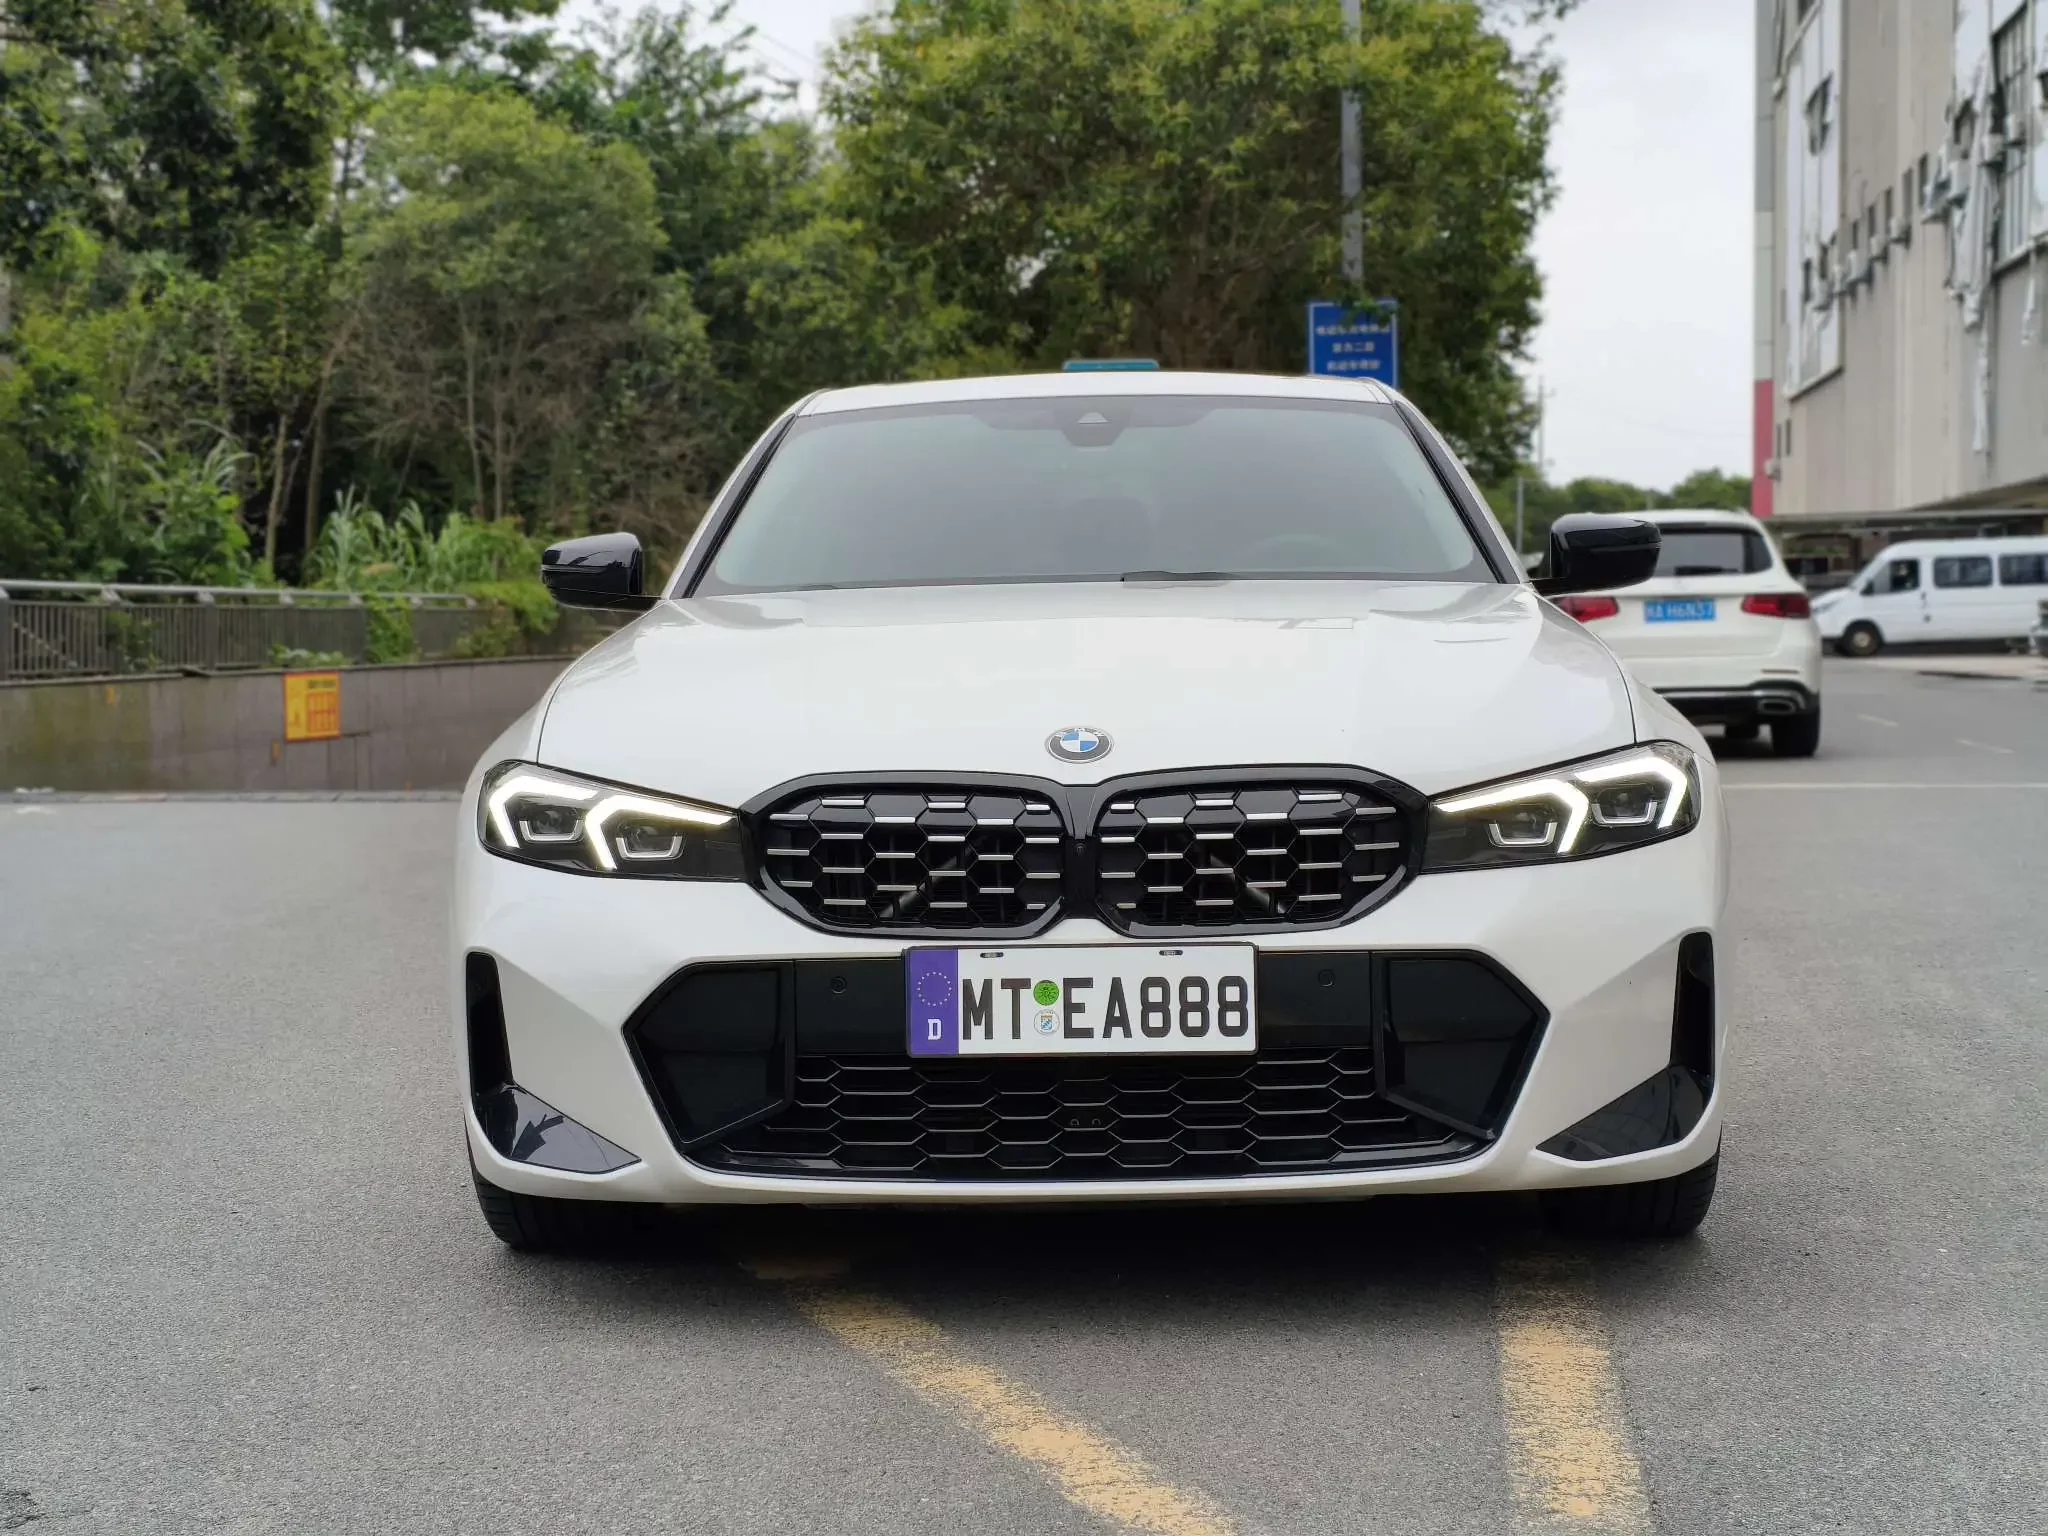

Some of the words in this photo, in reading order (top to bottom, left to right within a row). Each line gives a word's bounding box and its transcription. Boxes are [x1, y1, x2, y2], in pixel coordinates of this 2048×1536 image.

[927, 1018, 942, 1040] D
[963, 977, 1032, 1040] MT
[1063, 976, 1249, 1039] EA888
